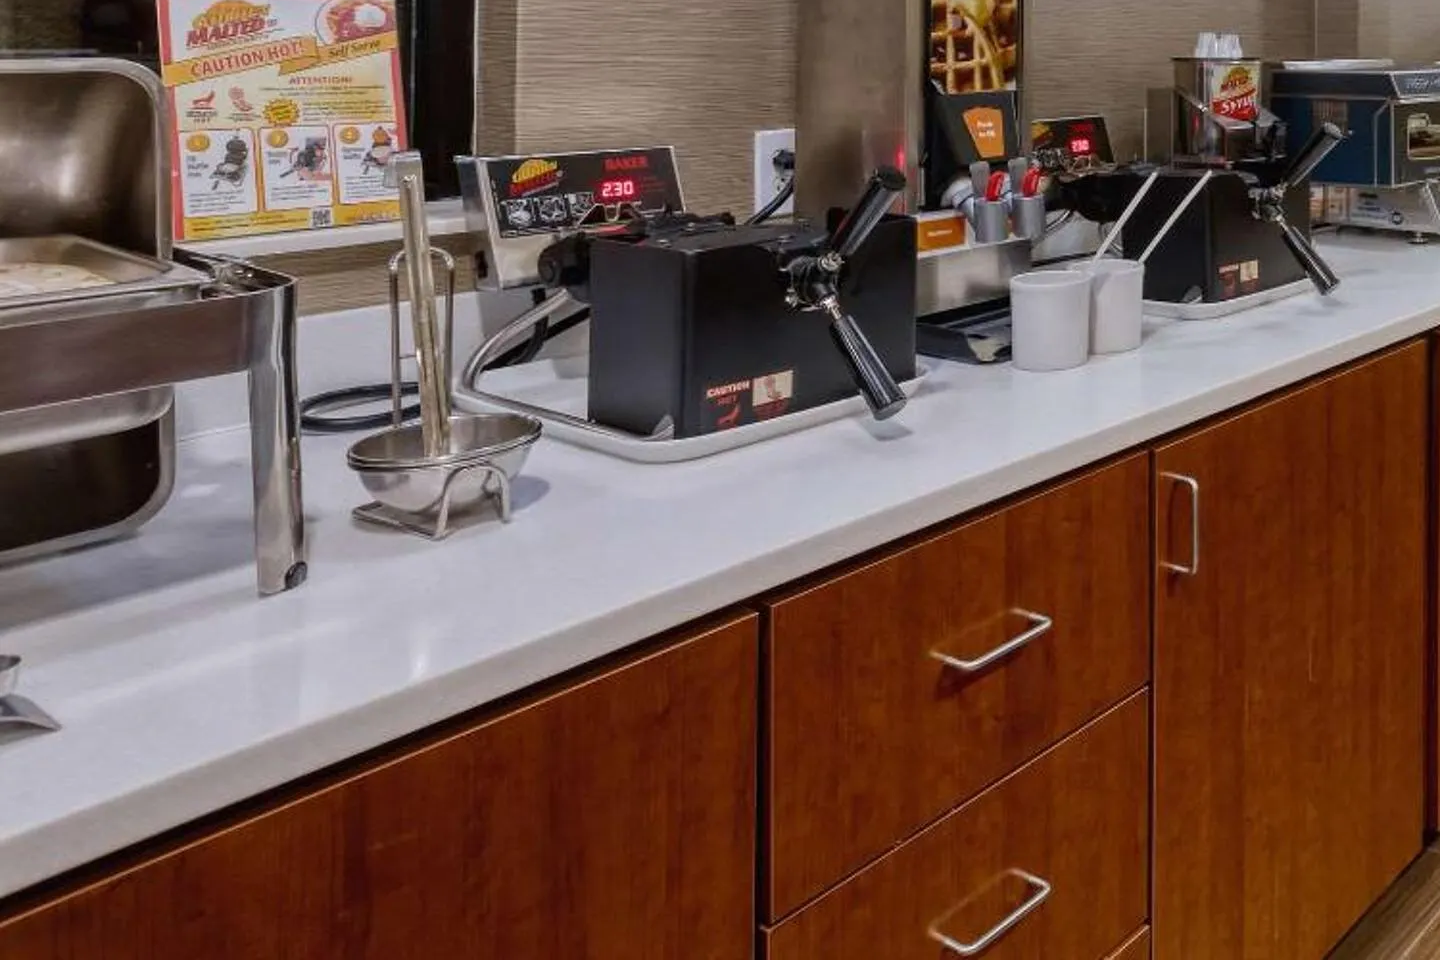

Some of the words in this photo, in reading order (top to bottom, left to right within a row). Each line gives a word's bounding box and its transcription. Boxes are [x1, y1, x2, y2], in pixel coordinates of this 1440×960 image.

[191, 50, 264, 76] CAUTION
[267, 40, 304, 59] HOT!
[329, 44, 349, 57] Self
